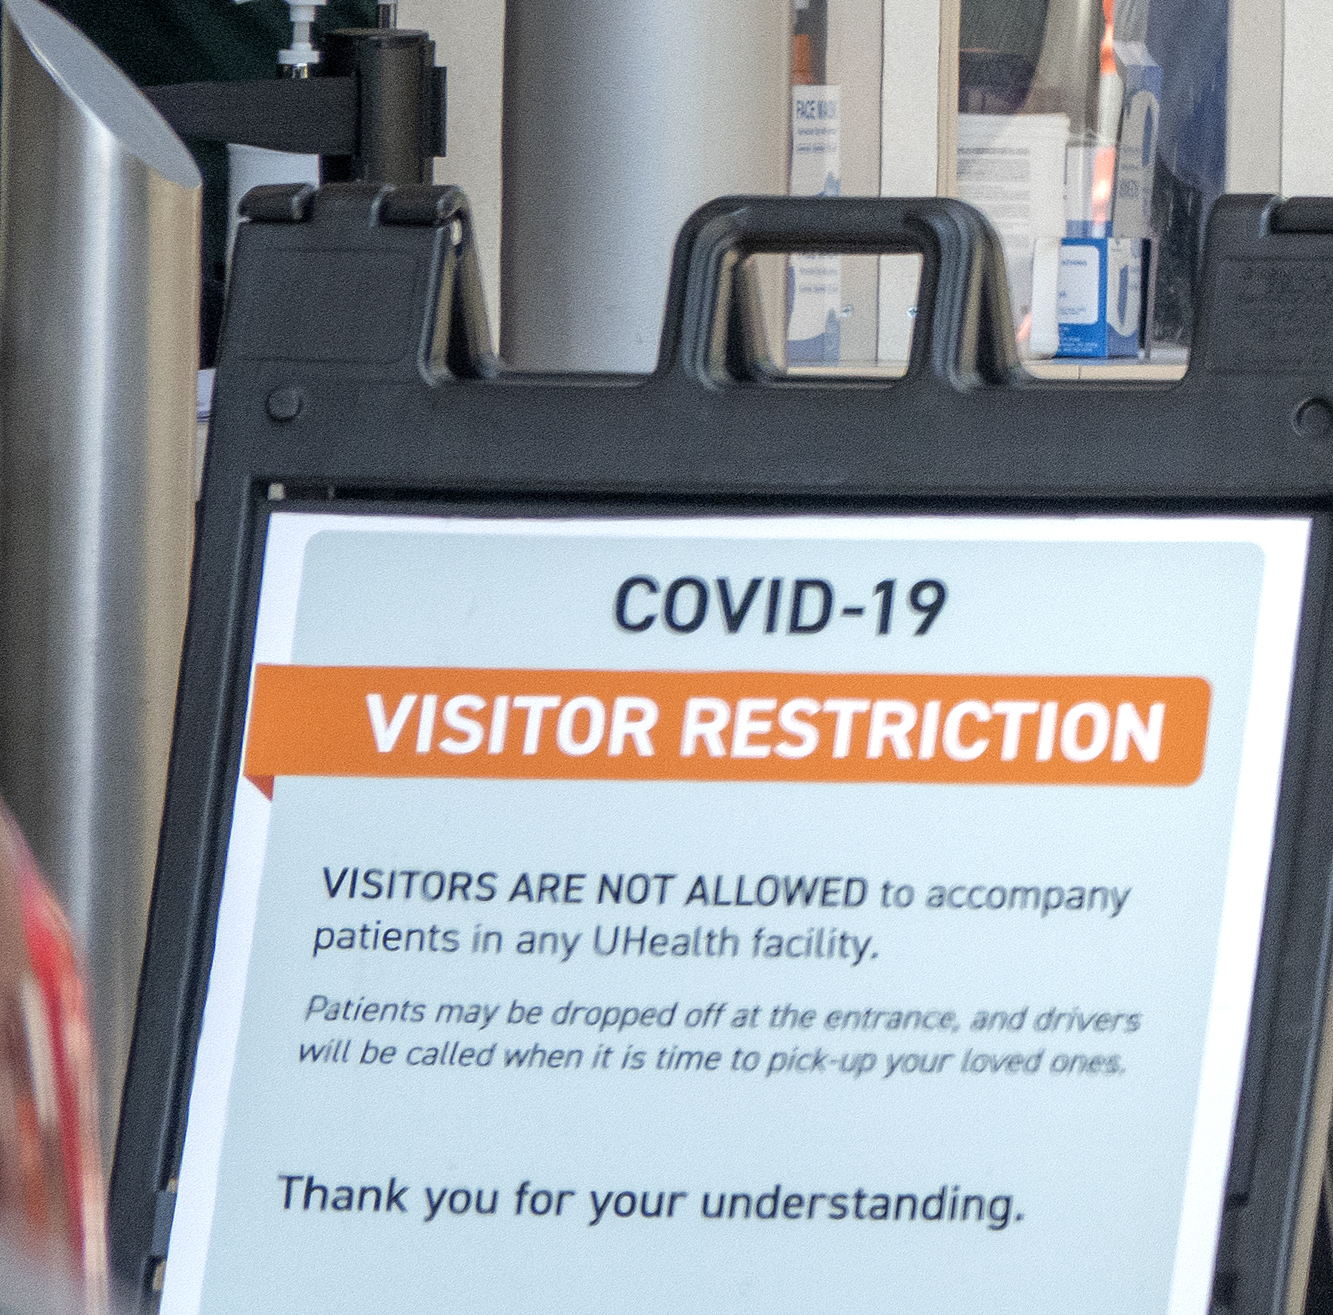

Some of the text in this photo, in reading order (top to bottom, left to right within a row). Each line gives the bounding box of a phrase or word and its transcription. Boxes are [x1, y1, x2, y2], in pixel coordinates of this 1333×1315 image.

[611, 572, 951, 639] COVID-19
[364, 692, 1167, 764] VISITOR RESTRICTION
[321, 865, 1133, 920] VISITORS ARE NOT ALLOWED to accompany
[310, 918, 880, 968] patients in any UHealth facility.
[303, 993, 1142, 1035] Patients may be dropped off at the entrance, and drivers
[297, 1036, 1127, 1080] will be called when it is time to pick-up your loved ones.
[276, 1172, 1026, 1234] Thank you for your understanding.
